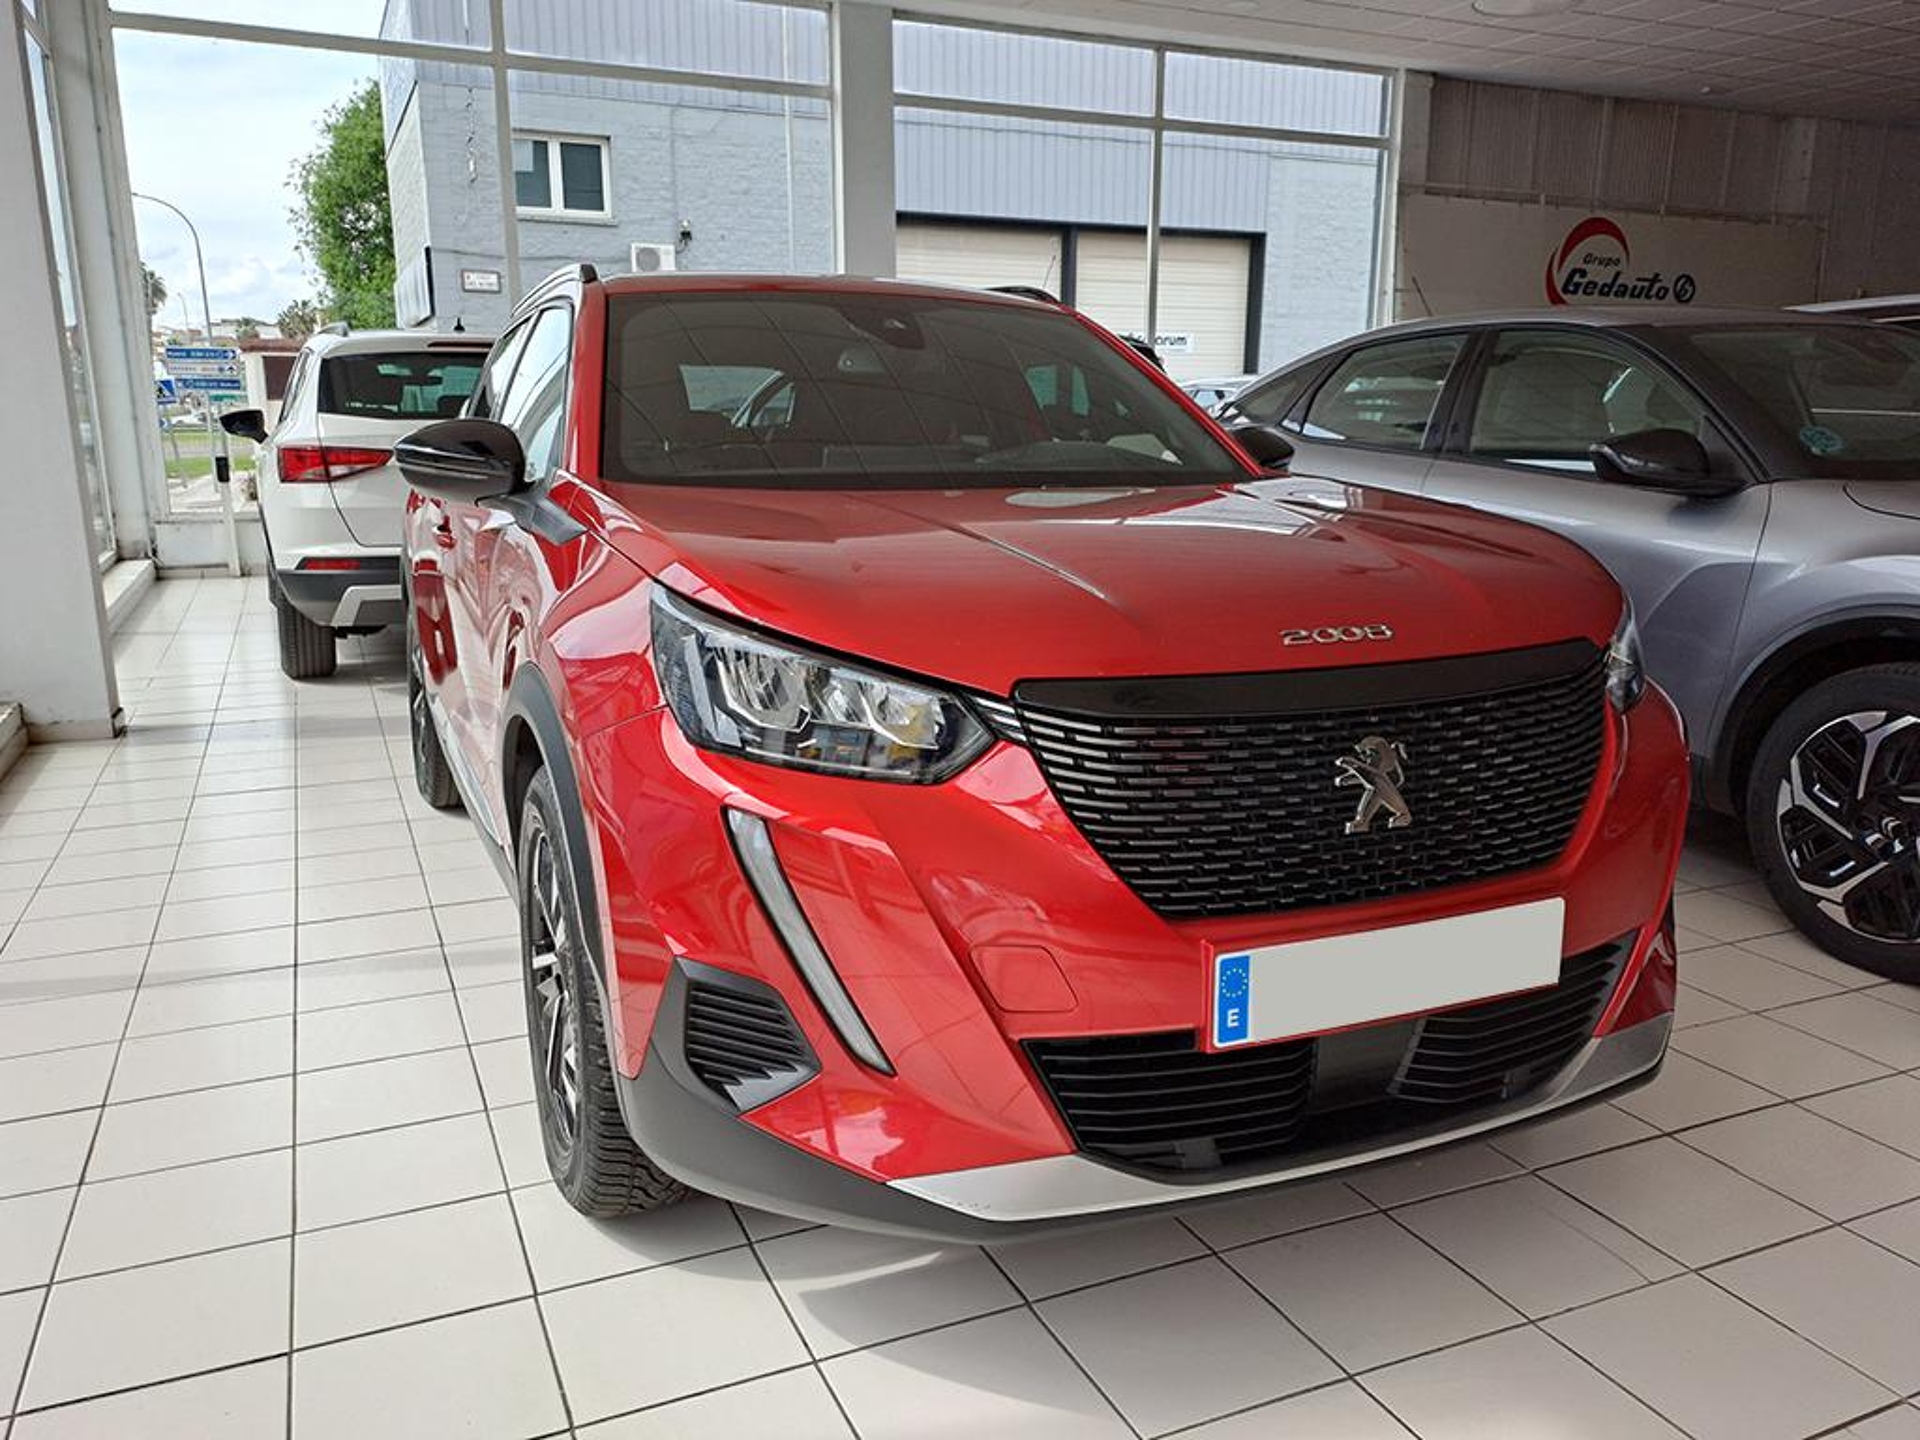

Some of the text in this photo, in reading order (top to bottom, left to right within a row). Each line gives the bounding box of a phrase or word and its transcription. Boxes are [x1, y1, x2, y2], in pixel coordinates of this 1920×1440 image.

[1583, 253, 1621, 267] Grupo
[1561, 267, 1670, 301] Gedauto
[1280, 624, 1393, 646] 2008
[1227, 1008, 1240, 1028] E
